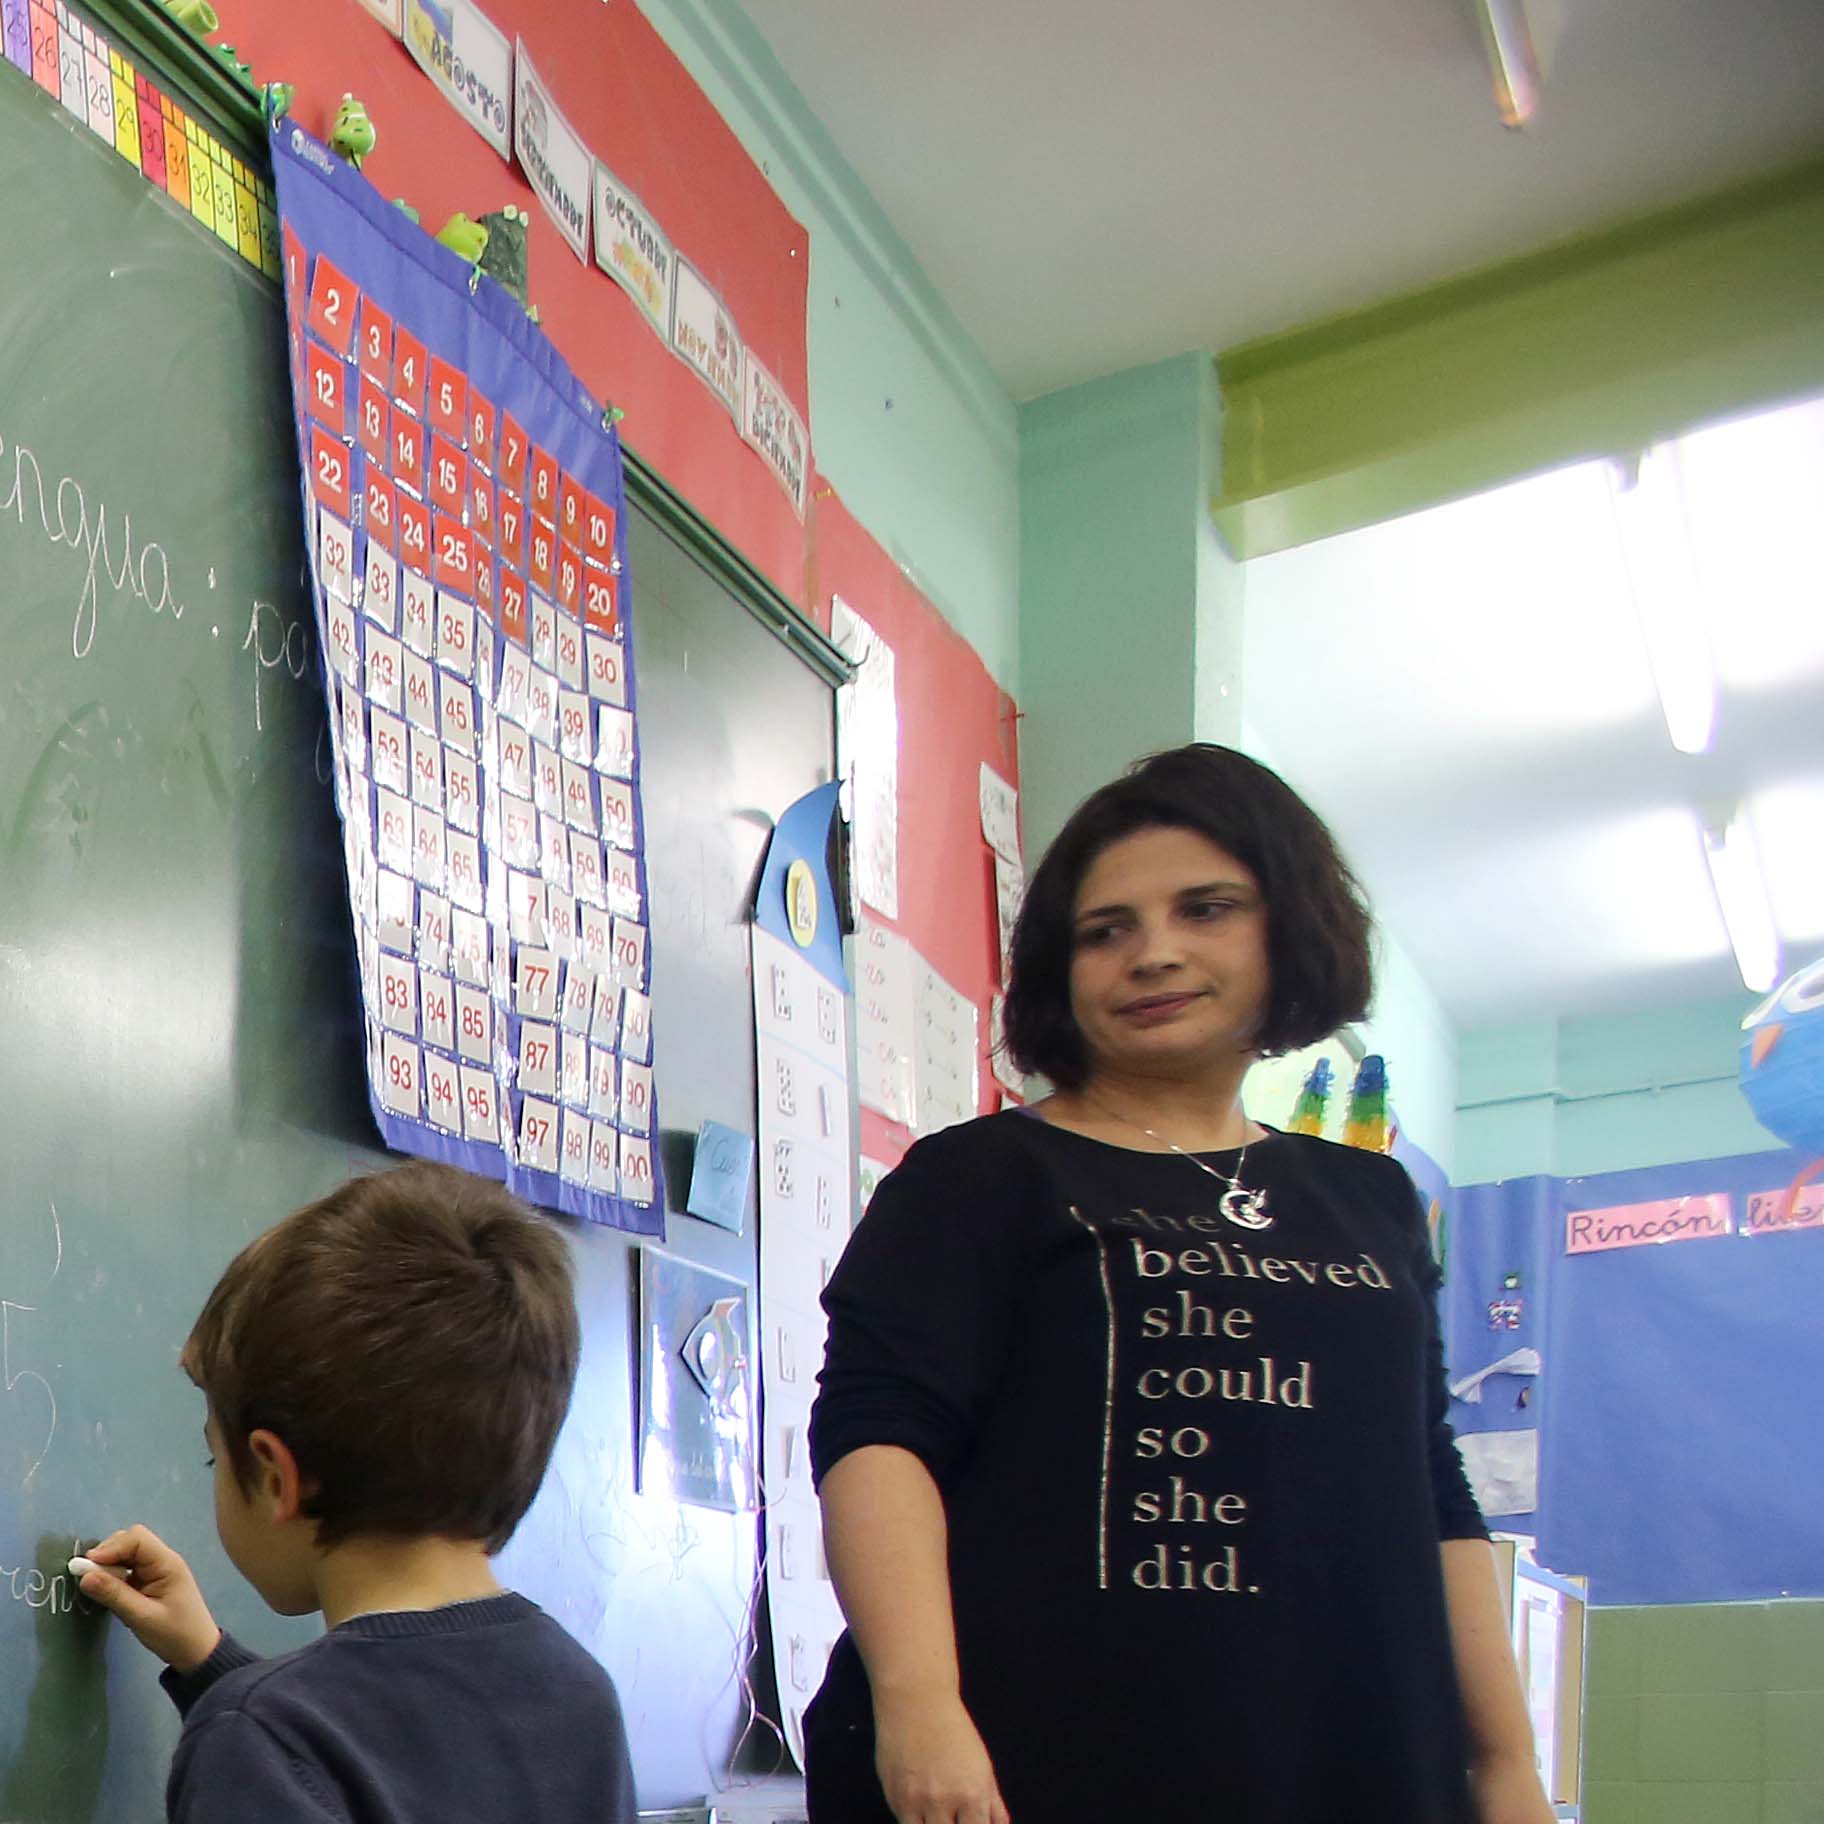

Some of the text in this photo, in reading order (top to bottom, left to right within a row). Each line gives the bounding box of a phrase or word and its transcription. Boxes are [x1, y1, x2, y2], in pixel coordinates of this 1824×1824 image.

[432, 32, 506, 133] AGOSTO
[34, 26, 56, 68] 26
[61, 51, 83, 96] 27
[90, 75, 111, 119] 28
[116, 99, 136, 141] 29
[144, 121, 165, 162] 30
[169, 143, 187, 185] 31
[192, 163, 210, 204] 32
[215, 184, 234, 223] 33
[324, 288, 606, 547] 2 3 4 5 6 7 8 9 10
[315, 368, 611, 617] 12 13 14 15 17 18 19 20
[319, 450, 342, 493] 22
[370, 484, 389, 526] 23
[403, 513, 424, 552] 24
[442, 535, 468, 572] 25
[505, 587, 522, 622] 27
[560, 633, 576, 665] 29
[593, 653, 617, 684] 30
[326, 535, 345, 574] 32
[371, 563, 390, 602] 33
[443, 614, 465, 650] 35
[445, 696, 467, 730] 45
[616, 936, 638, 967] 70
[524, 965, 550, 995] 77
[570, 978, 586, 1010] 78
[385, 975, 549, 1072] 83 84 85 87
[390, 1055, 610, 1170] 93 94 95 97 99
[1569, 1211, 1722, 1247] Rincón
[1131, 1238, 1394, 1290] believed
[1141, 1291, 1255, 1340] she
[1136, 1357, 1315, 1410] could
[1135, 1426, 1210, 1459] so
[1133, 1476, 1247, 1525] she
[1132, 1545, 1263, 1595] did.
